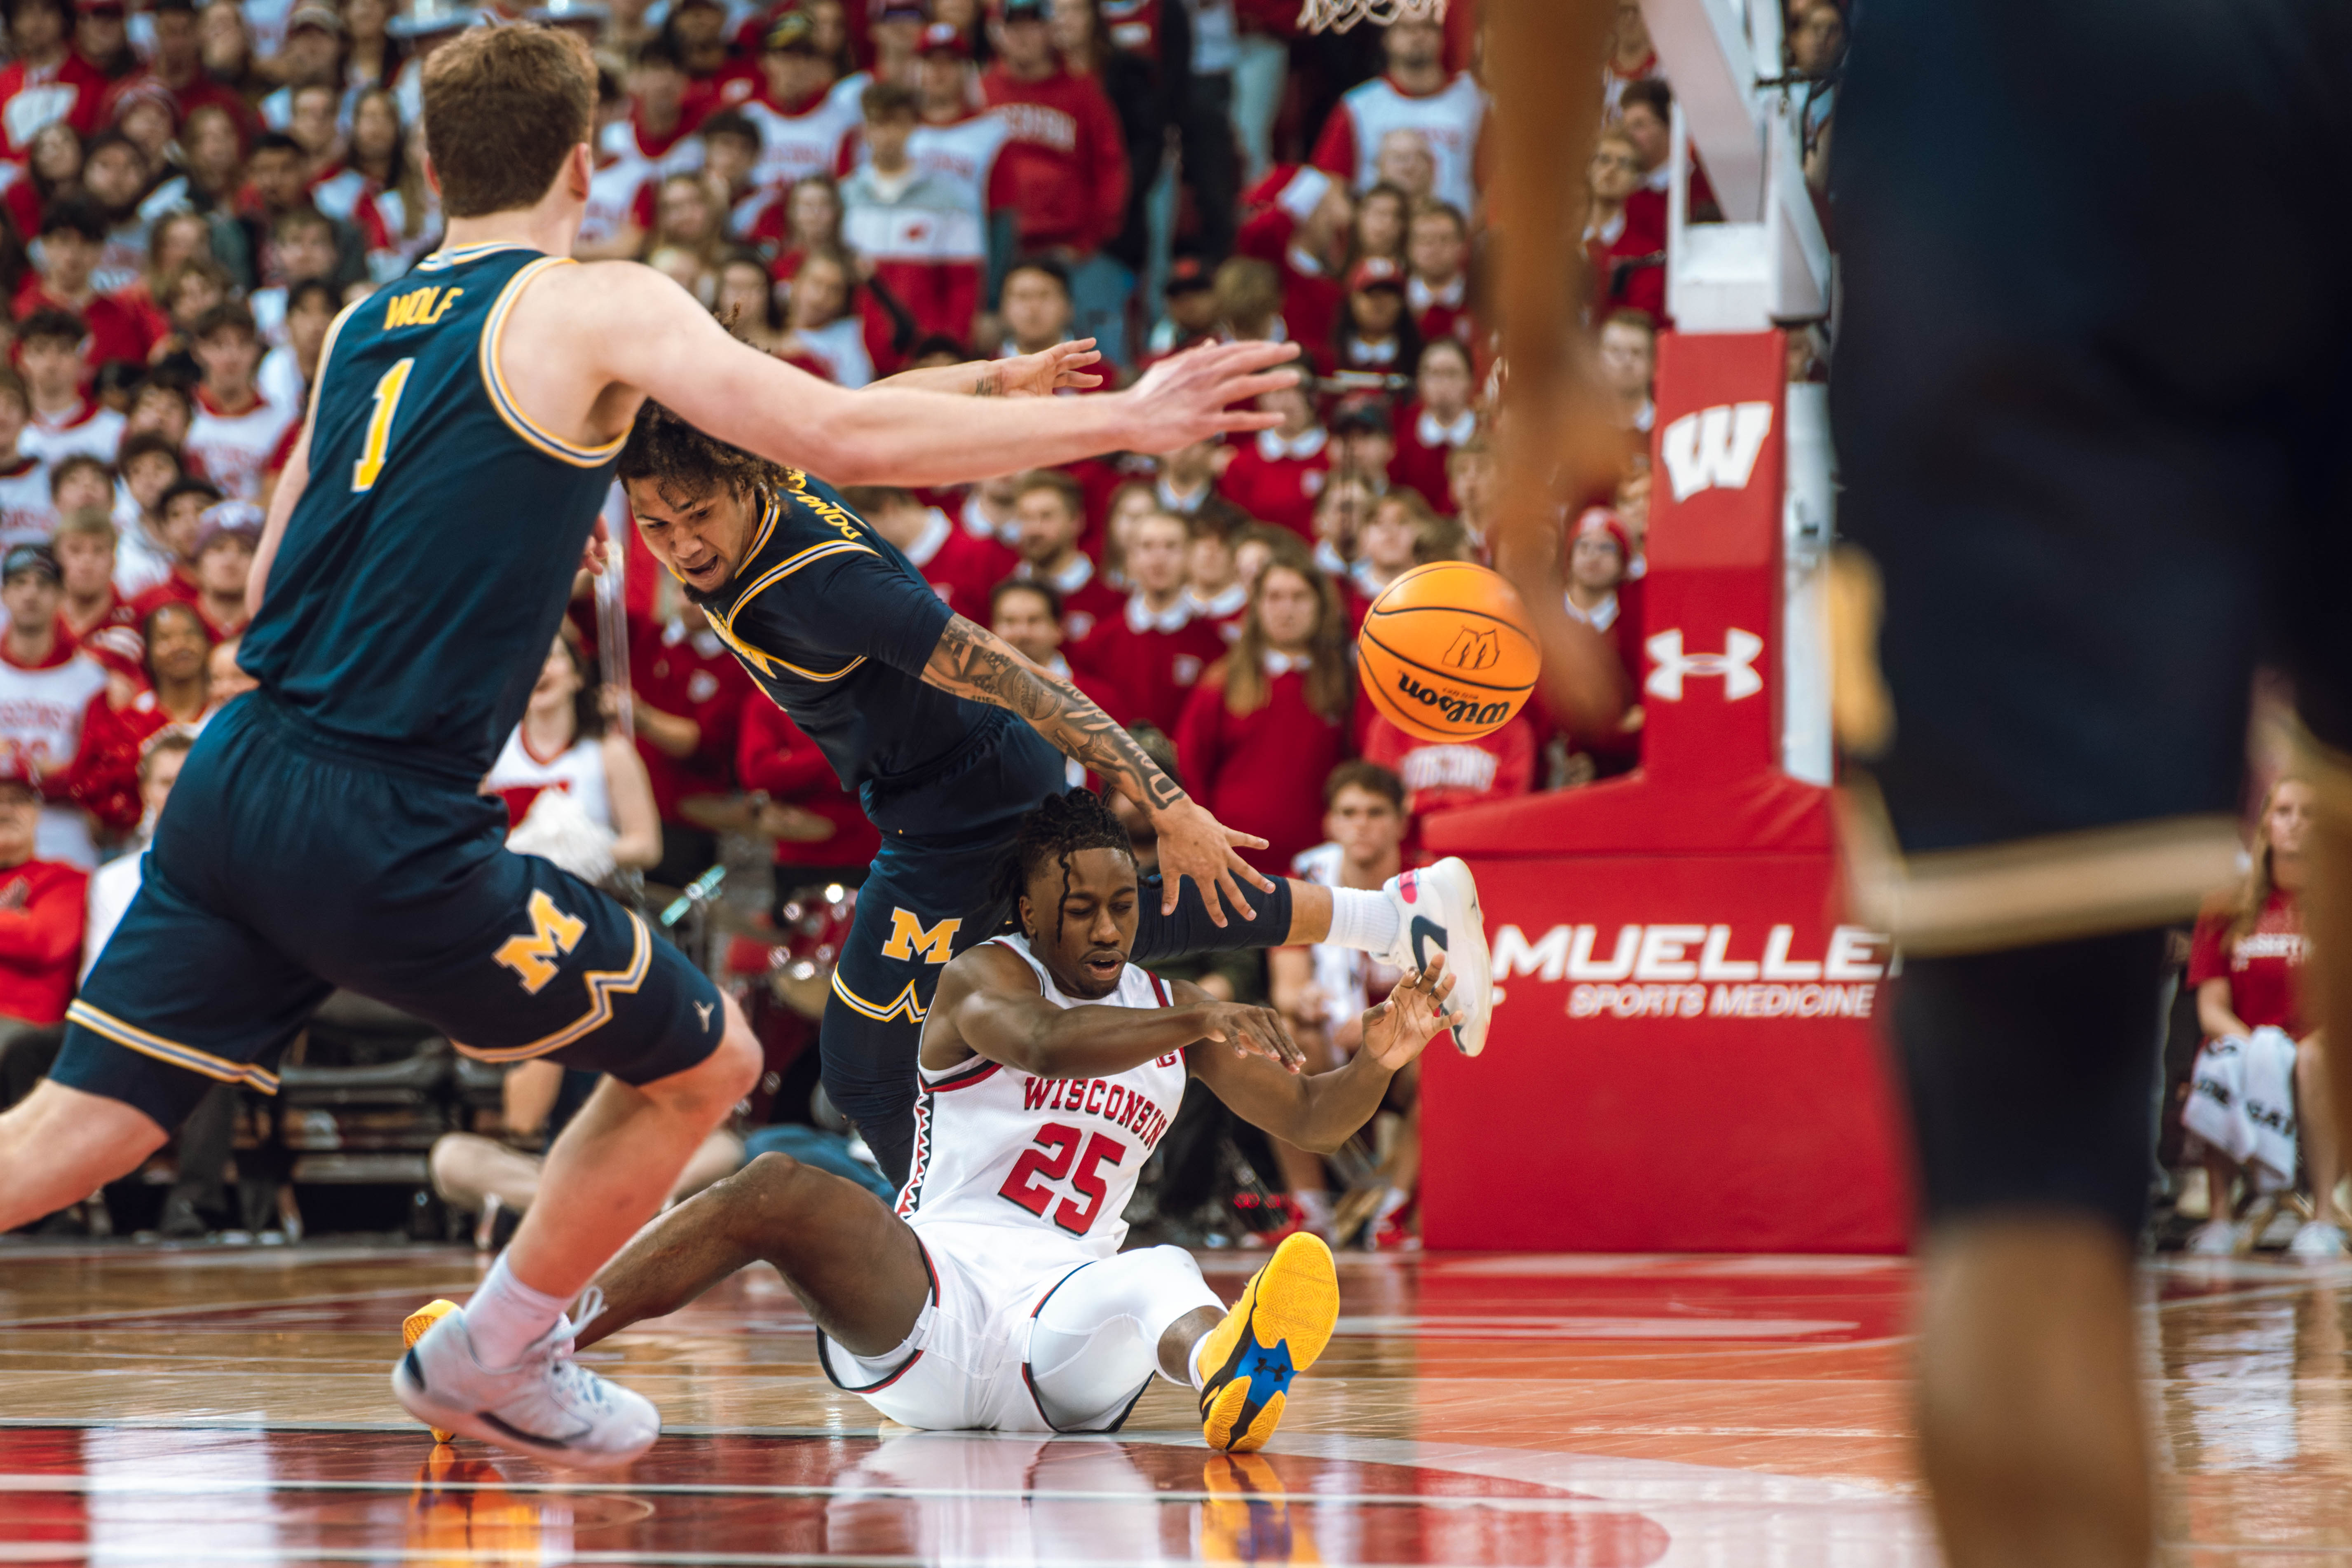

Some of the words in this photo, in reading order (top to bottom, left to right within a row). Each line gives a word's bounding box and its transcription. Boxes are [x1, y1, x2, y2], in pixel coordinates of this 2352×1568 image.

[383, 286, 464, 331] WOLF
[350, 356, 415, 495] 1
[1661, 401, 1774, 503] W
[1398, 671, 1511, 725] Wilson
[491, 888, 588, 996] M
[881, 905, 963, 965] M
[1492, 924, 1903, 982] MUELLE
[1568, 983, 1706, 1018] SPORTS
[1709, 983, 1877, 1018] MEDICINE
[1024, 1077, 1168, 1151] WISCONSIN
[997, 1122, 1127, 1236] 25
